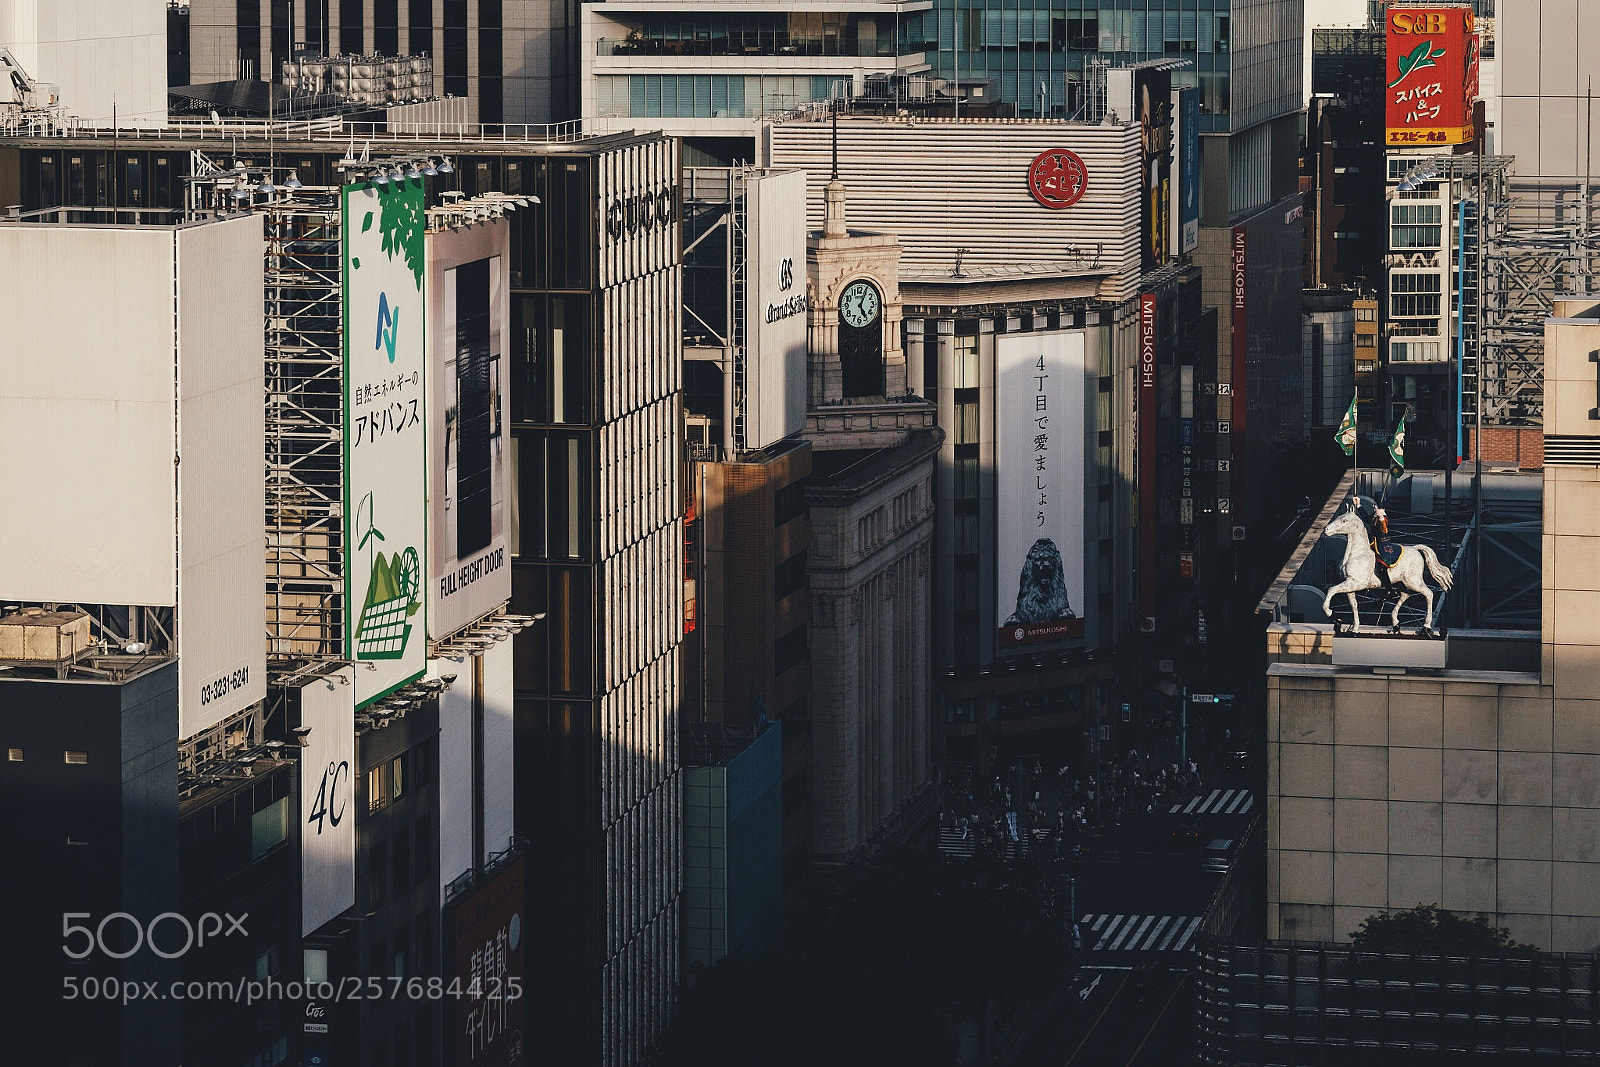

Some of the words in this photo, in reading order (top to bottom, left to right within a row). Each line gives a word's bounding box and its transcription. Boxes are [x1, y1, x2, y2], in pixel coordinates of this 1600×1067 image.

[1392, 12, 1447, 35] S&B
[1395, 82, 1443, 104] スパイス
[1417, 99, 1428, 110] &
[1390, 131, 1447, 142] エスビー食品
[608, 186, 678, 241] GUCCI
[779, 257, 793, 291] GS
[1235, 233, 1245, 308] MITSUKOSHI
[1143, 301, 1153, 387] MITSUKOSHI
[355, 371, 419, 406] 自然エネルギーの
[355, 399, 419, 447] アドバンス
[1033, 354, 1049, 527] 4丁目で愛ましょう
[441, 572, 457, 599] FULL
[459, 558, 483, 589] HEIGHT
[485, 547, 503, 575] DOOR
[1027, 626, 1067, 636] MITSUKOSHI
[202, 665, 249, 706] 03-3231-6241
